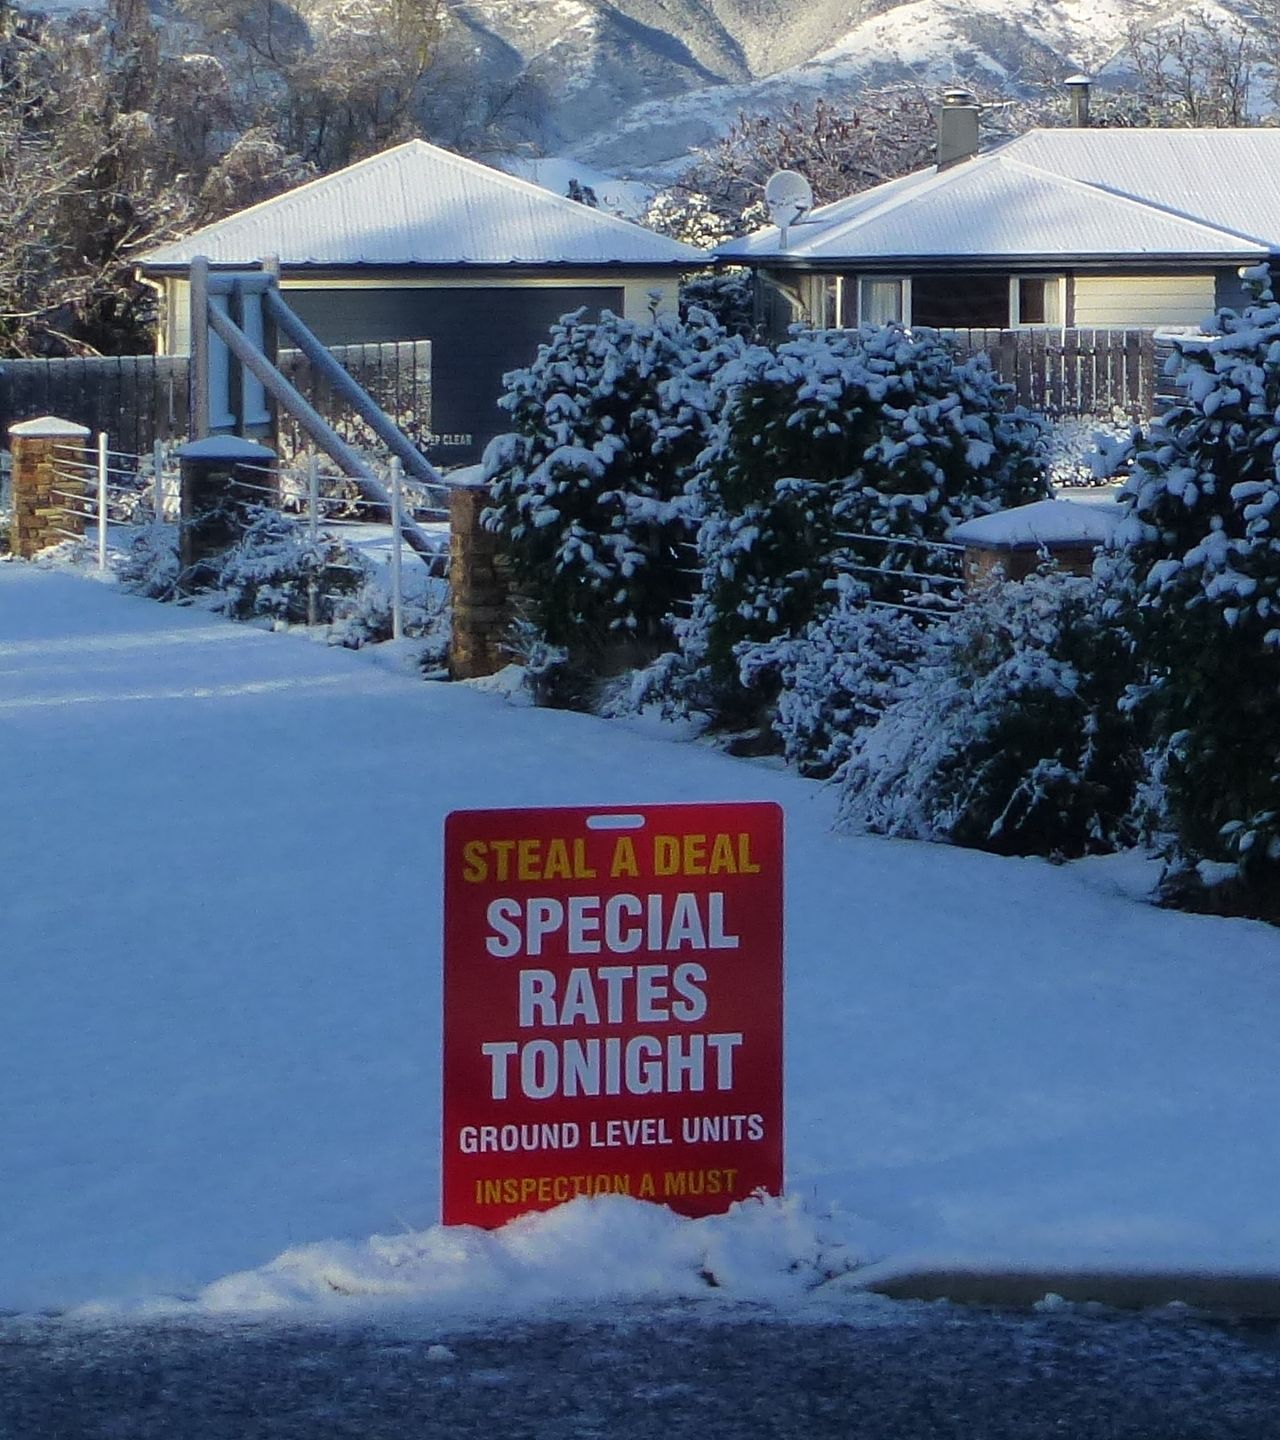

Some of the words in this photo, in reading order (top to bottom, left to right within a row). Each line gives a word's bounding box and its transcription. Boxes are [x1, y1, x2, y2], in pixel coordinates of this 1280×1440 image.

[462, 837, 597, 883] STEAL
[610, 835, 639, 878] A
[654, 832, 761, 876] DEAL
[485, 891, 740, 958] SPECIAL
[518, 962, 709, 1027] RATES
[482, 1032, 743, 1100] TONIGHT
[459, 1122, 580, 1154] GROUND
[590, 1118, 673, 1148] LEVEL
[682, 1114, 765, 1143] UNITS
[475, 1173, 630, 1205] INSPECTION
[638, 1172, 656, 1197] A
[663, 1168, 740, 1197] MUST
